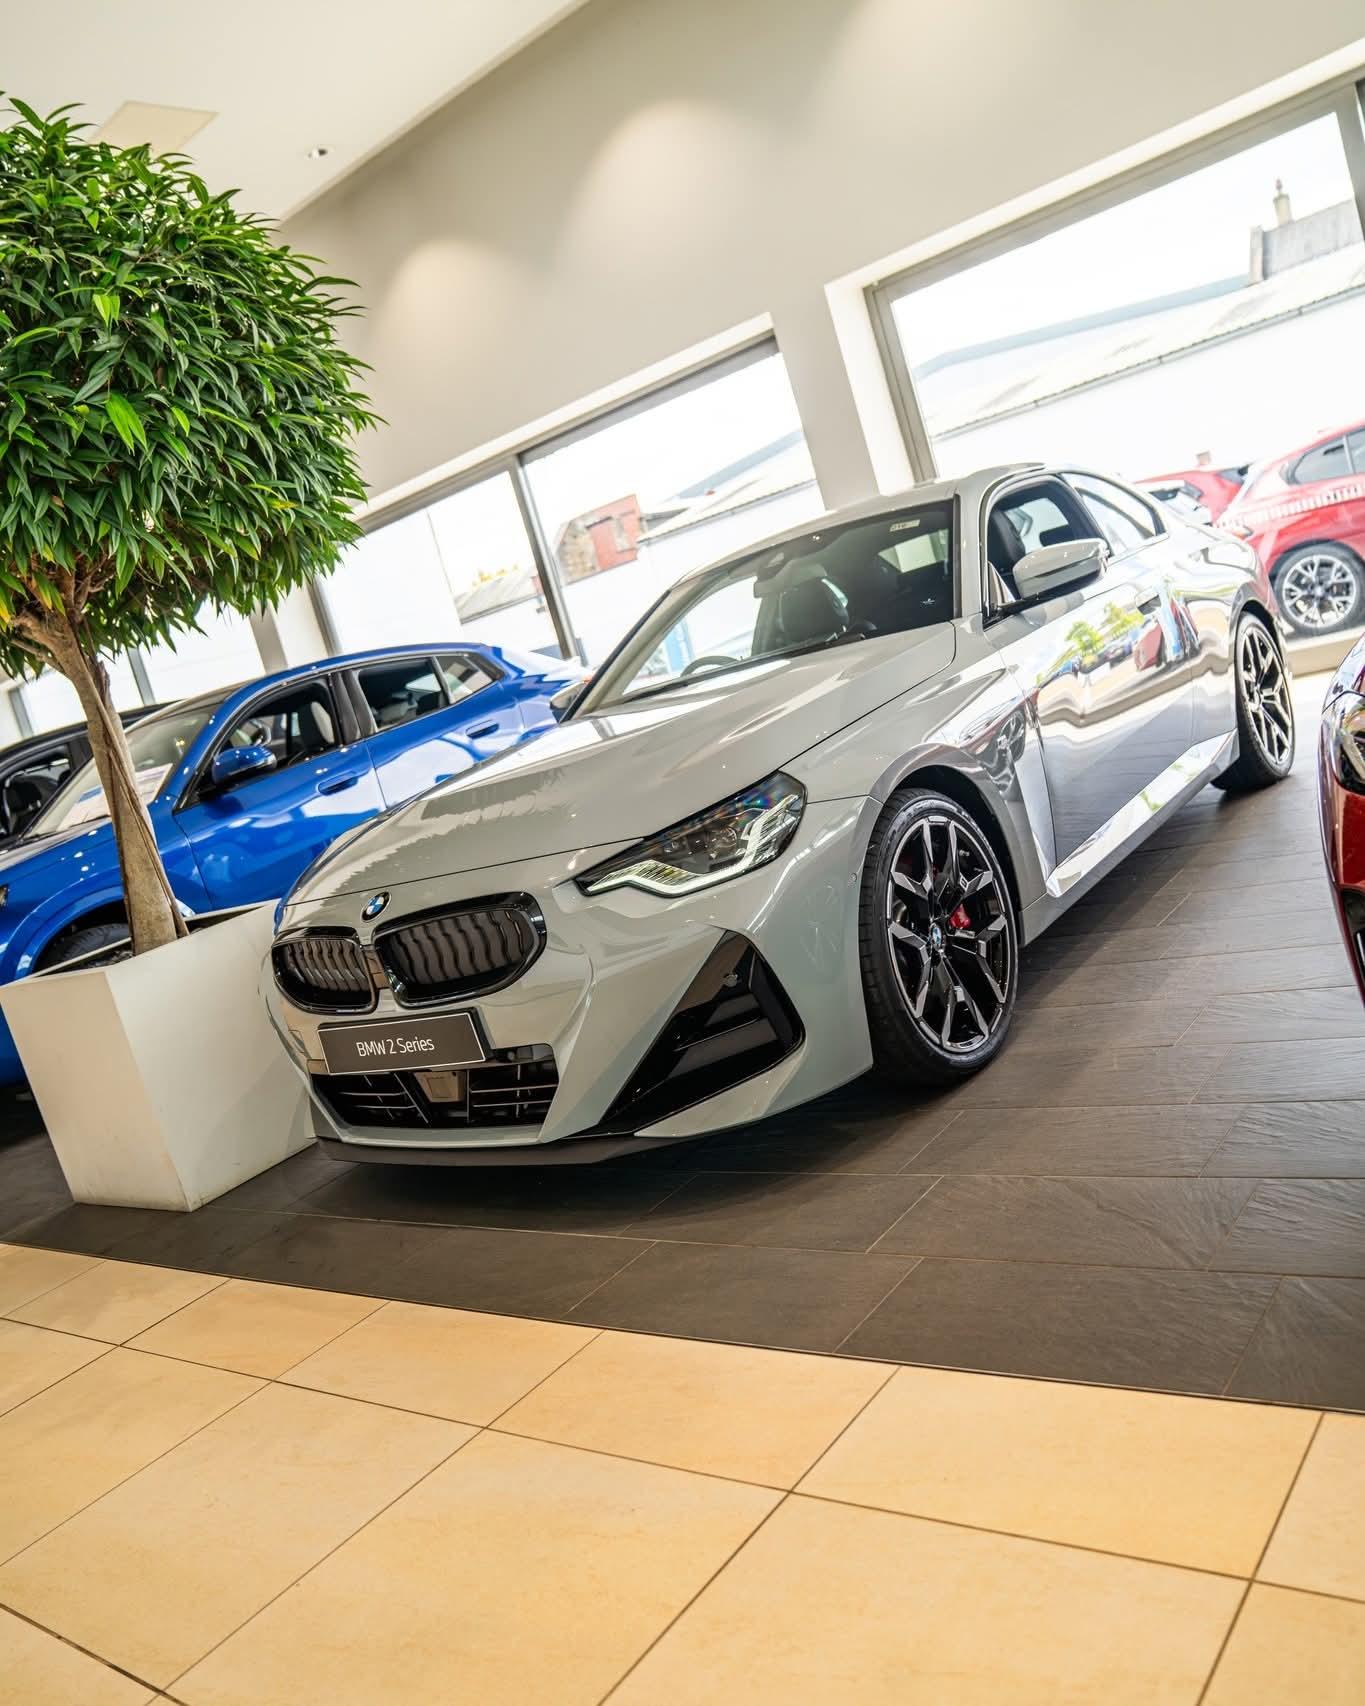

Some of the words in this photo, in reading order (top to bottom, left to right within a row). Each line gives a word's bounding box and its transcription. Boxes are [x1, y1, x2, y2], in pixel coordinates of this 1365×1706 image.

[356, 1040, 386, 1057] BMW
[386, 1038, 397, 1055] 2
[396, 1036, 435, 1054] Series
